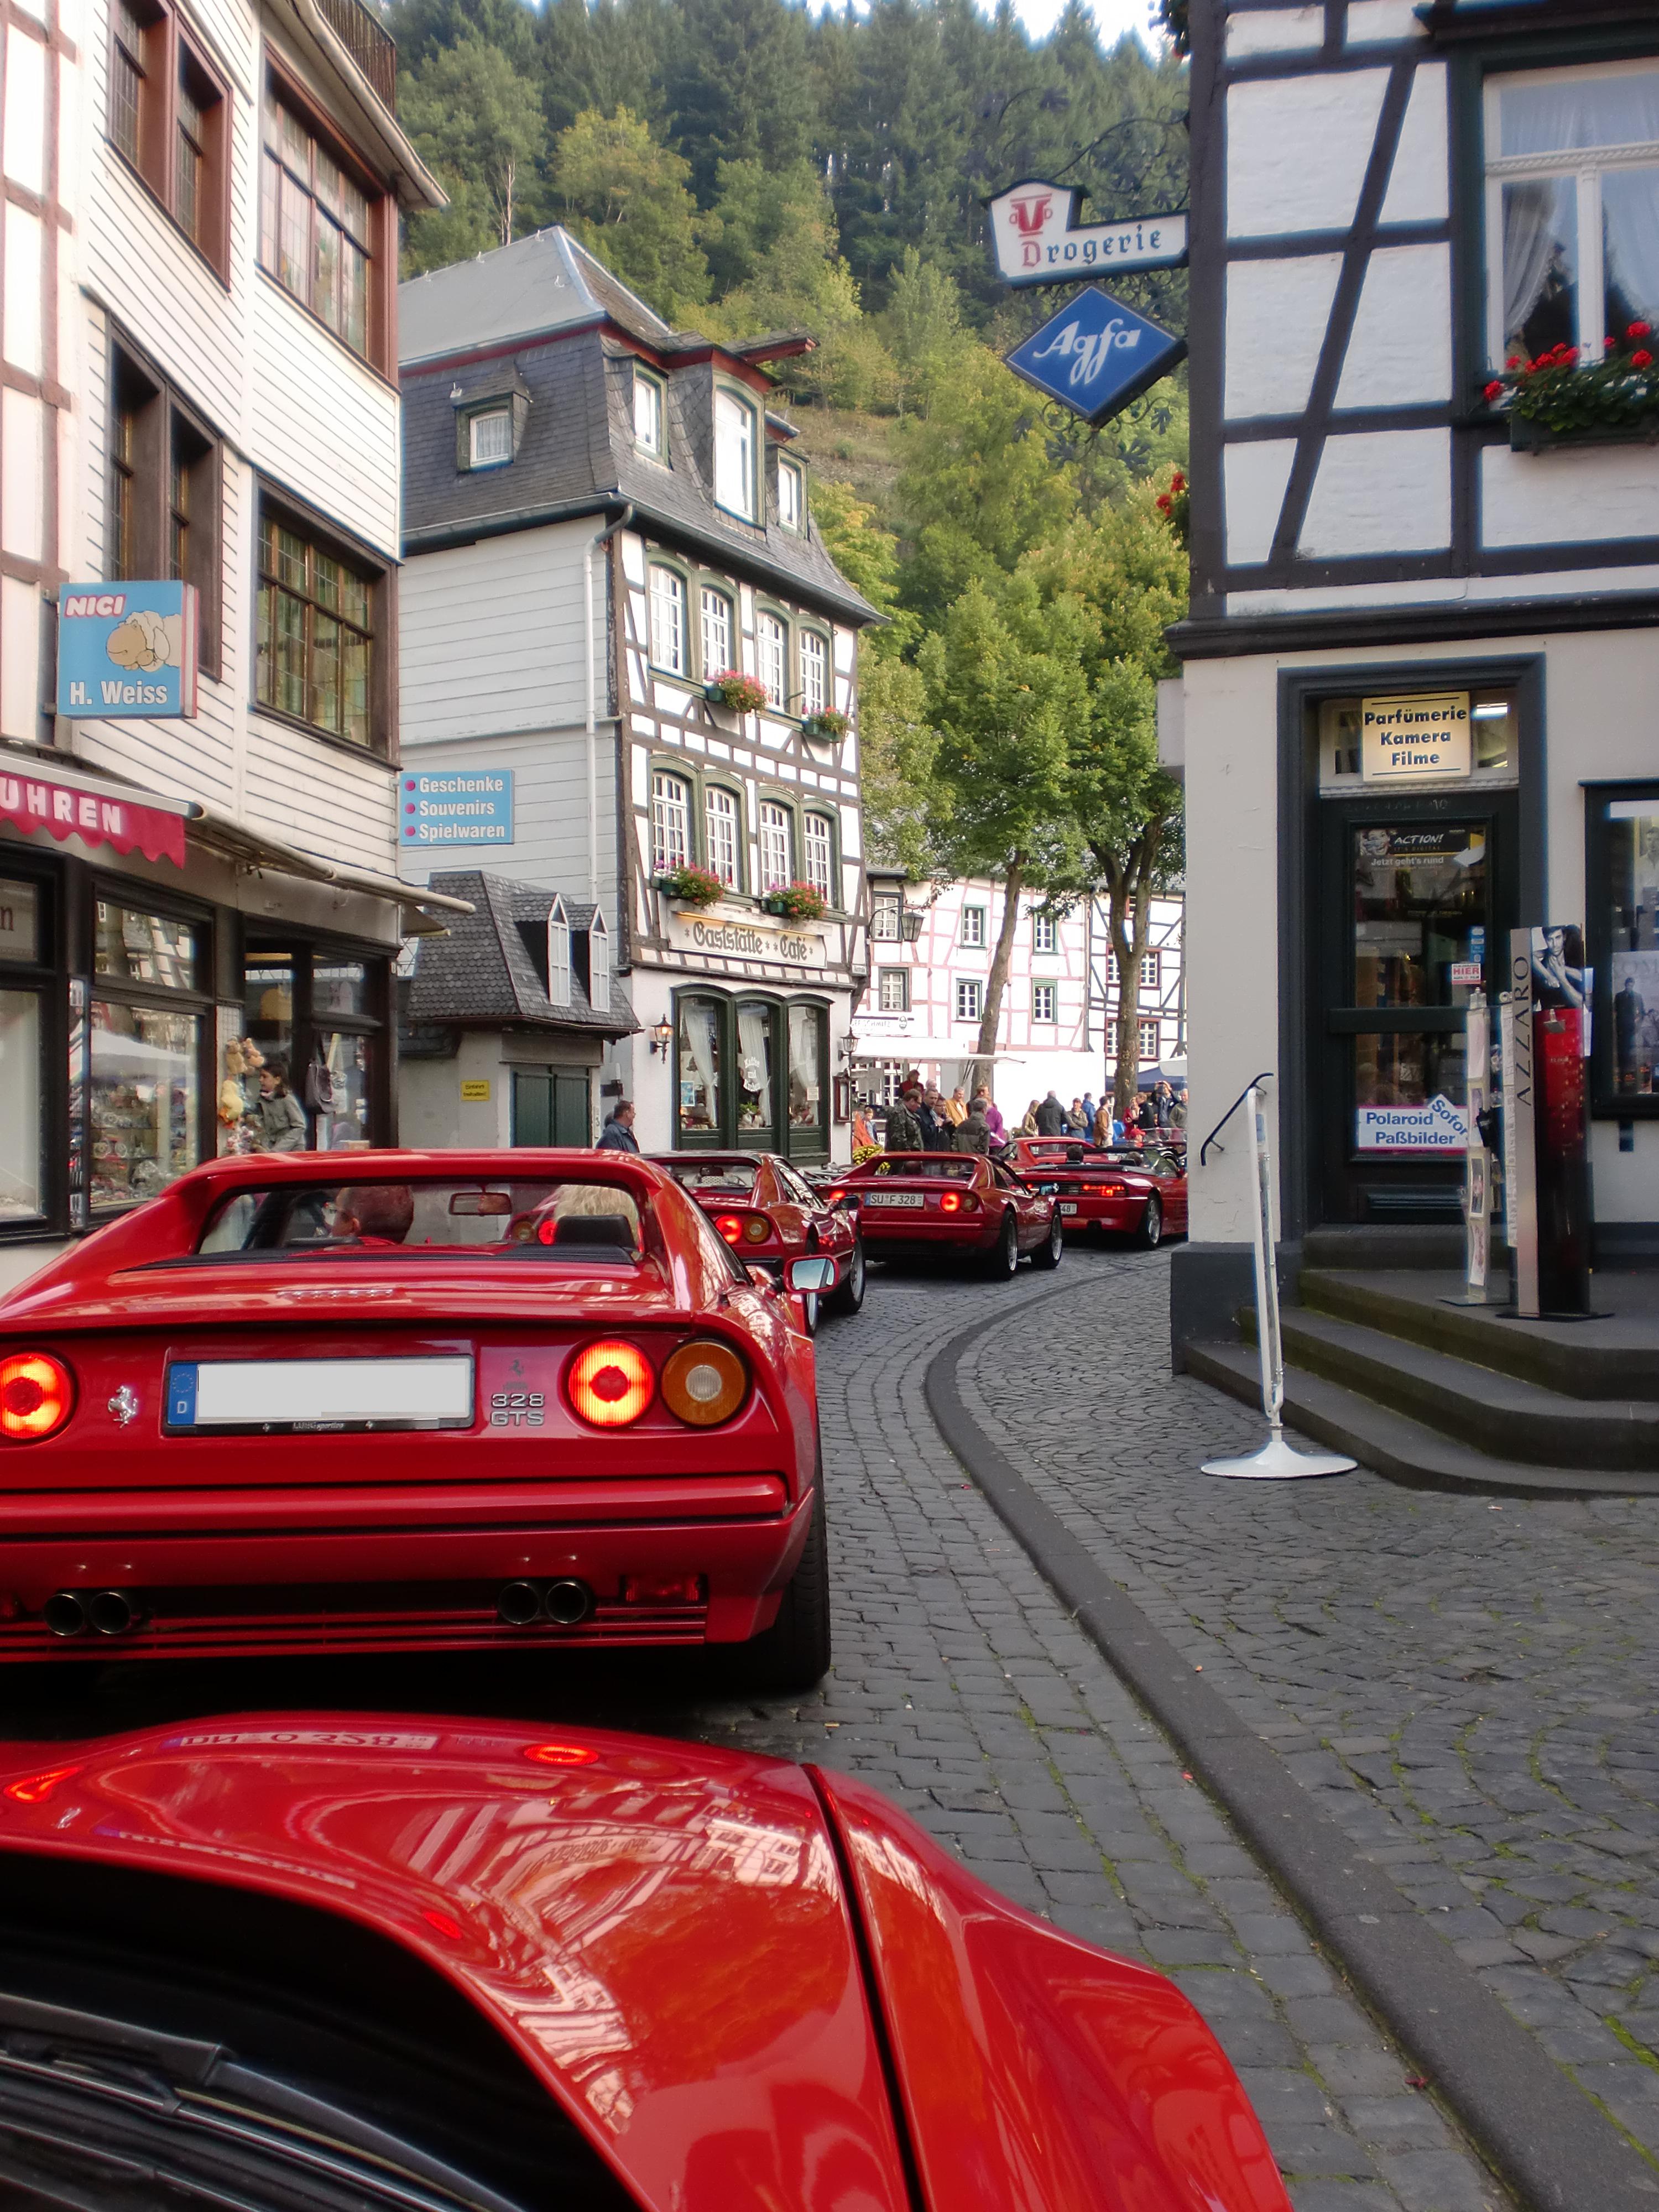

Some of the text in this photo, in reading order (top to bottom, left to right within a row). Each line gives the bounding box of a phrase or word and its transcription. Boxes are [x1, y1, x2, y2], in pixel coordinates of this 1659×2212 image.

[1021, 224, 1161, 268] Drogerie
[1033, 318, 1141, 385] Agfa
[65, 595, 126, 618] NICI
[70, 680, 167, 705] H. Weiss
[1365, 705, 1467, 726] Parfümerie
[1381, 732, 1451, 745] Kamera
[1392, 751, 1440, 766] Filme
[419, 776, 503, 792] Geschenke
[0, 776, 121, 834] UHREN
[419, 800, 494, 816] Souvenirs
[419, 823, 505, 842] Spielwaren
[1394, 834, 1445, 844] ACTION!
[1396, 858, 1421, 867] geht's
[693, 921, 807, 961] Gaststätte Café
[1513, 956, 1531, 1106] AZZARO
[1366, 1112, 1433, 1125] Polaroid
[1431, 1099, 1468, 1137] Sofor
[1375, 1131, 1455, 1144] Paßbilder
[870, 1194, 884, 1204] SU
[889, 1195, 896, 1204] F
[898, 1195, 916, 1204] 328
[176, 1401, 187, 1414] D
[492, 1392, 545, 1407] 328
[491, 1411, 545, 1427] GTS
